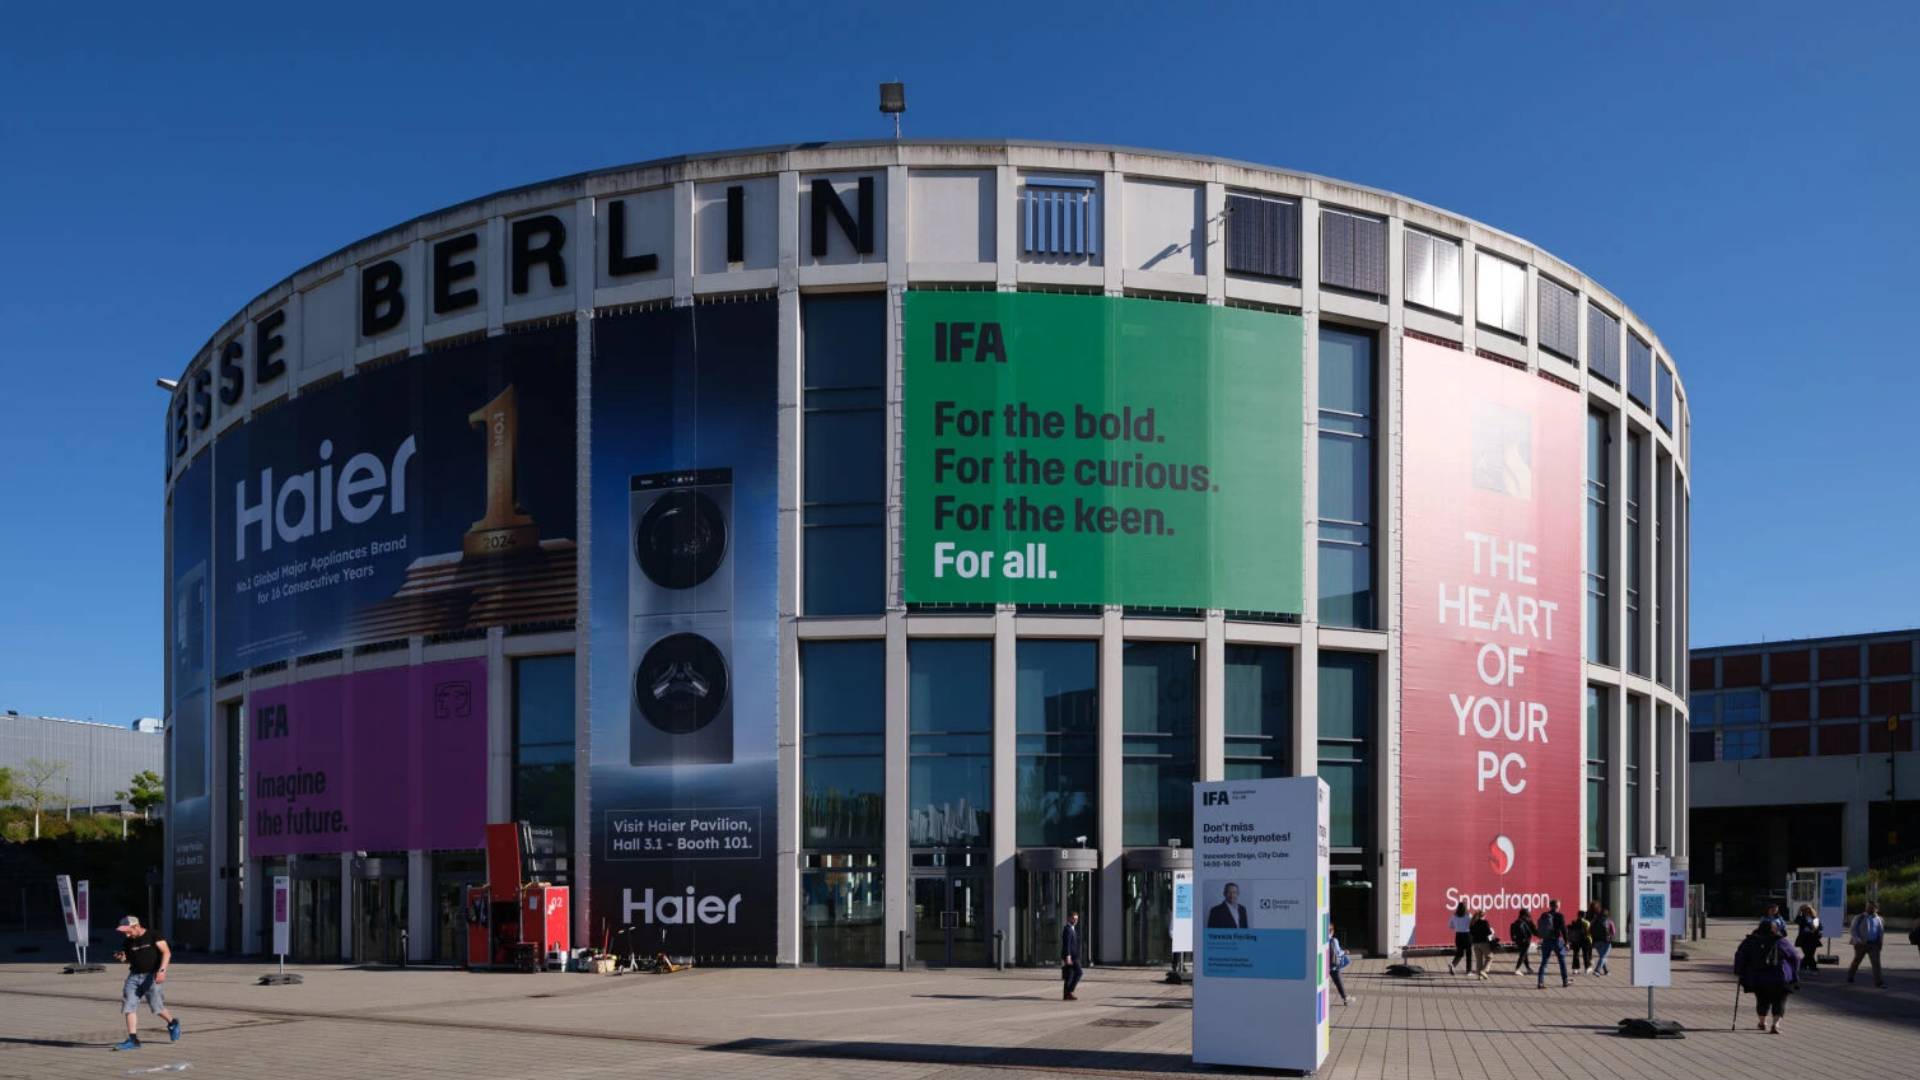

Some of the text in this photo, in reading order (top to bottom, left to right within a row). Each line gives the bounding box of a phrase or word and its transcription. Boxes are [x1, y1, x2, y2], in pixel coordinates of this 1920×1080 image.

[362, 176, 874, 337] BERLIN
[935, 322, 1007, 363] IFA
[934, 401, 1165, 443] For the bold.
[934, 448, 1220, 493] For the curious.
[236, 434, 417, 562] Haier
[934, 495, 1175, 536] For the keen.
[253, 567, 280, 588] Global
[282, 559, 308, 577] Major
[310, 546, 368, 570] Appliances
[371, 534, 407, 555] Brand
[482, 535, 517, 550] 2024
[934, 542, 1057, 579] For all.
[1465, 531, 1537, 586] THE
[257, 565, 375, 604] for 16 Consecutive Years
[1439, 583, 1559, 640] HEART
[1477, 643, 1528, 687] OF
[257, 704, 289, 740] IFA
[1449, 693, 1549, 743] YOUR
[257, 765, 326, 803] Imagine
[1477, 751, 1527, 794] PC
[1203, 791, 1229, 806] IFA
[257, 806, 348, 837] the future.
[613, 817, 752, 833] Visit Haier Pavilion,
[1203, 822, 1254, 832] Don't miss
[1203, 832, 1291, 845] today's keynotes!
[613, 838, 640, 850] Hall
[643, 838, 663, 850] 3.1
[677, 837, 719, 850] Booth
[724, 836, 752, 850] 101.
[1638, 861, 1650, 869] IFA
[176, 889, 202, 920] Haier
[623, 886, 742, 924] Haier
[1445, 887, 1550, 912] Snapdragon
